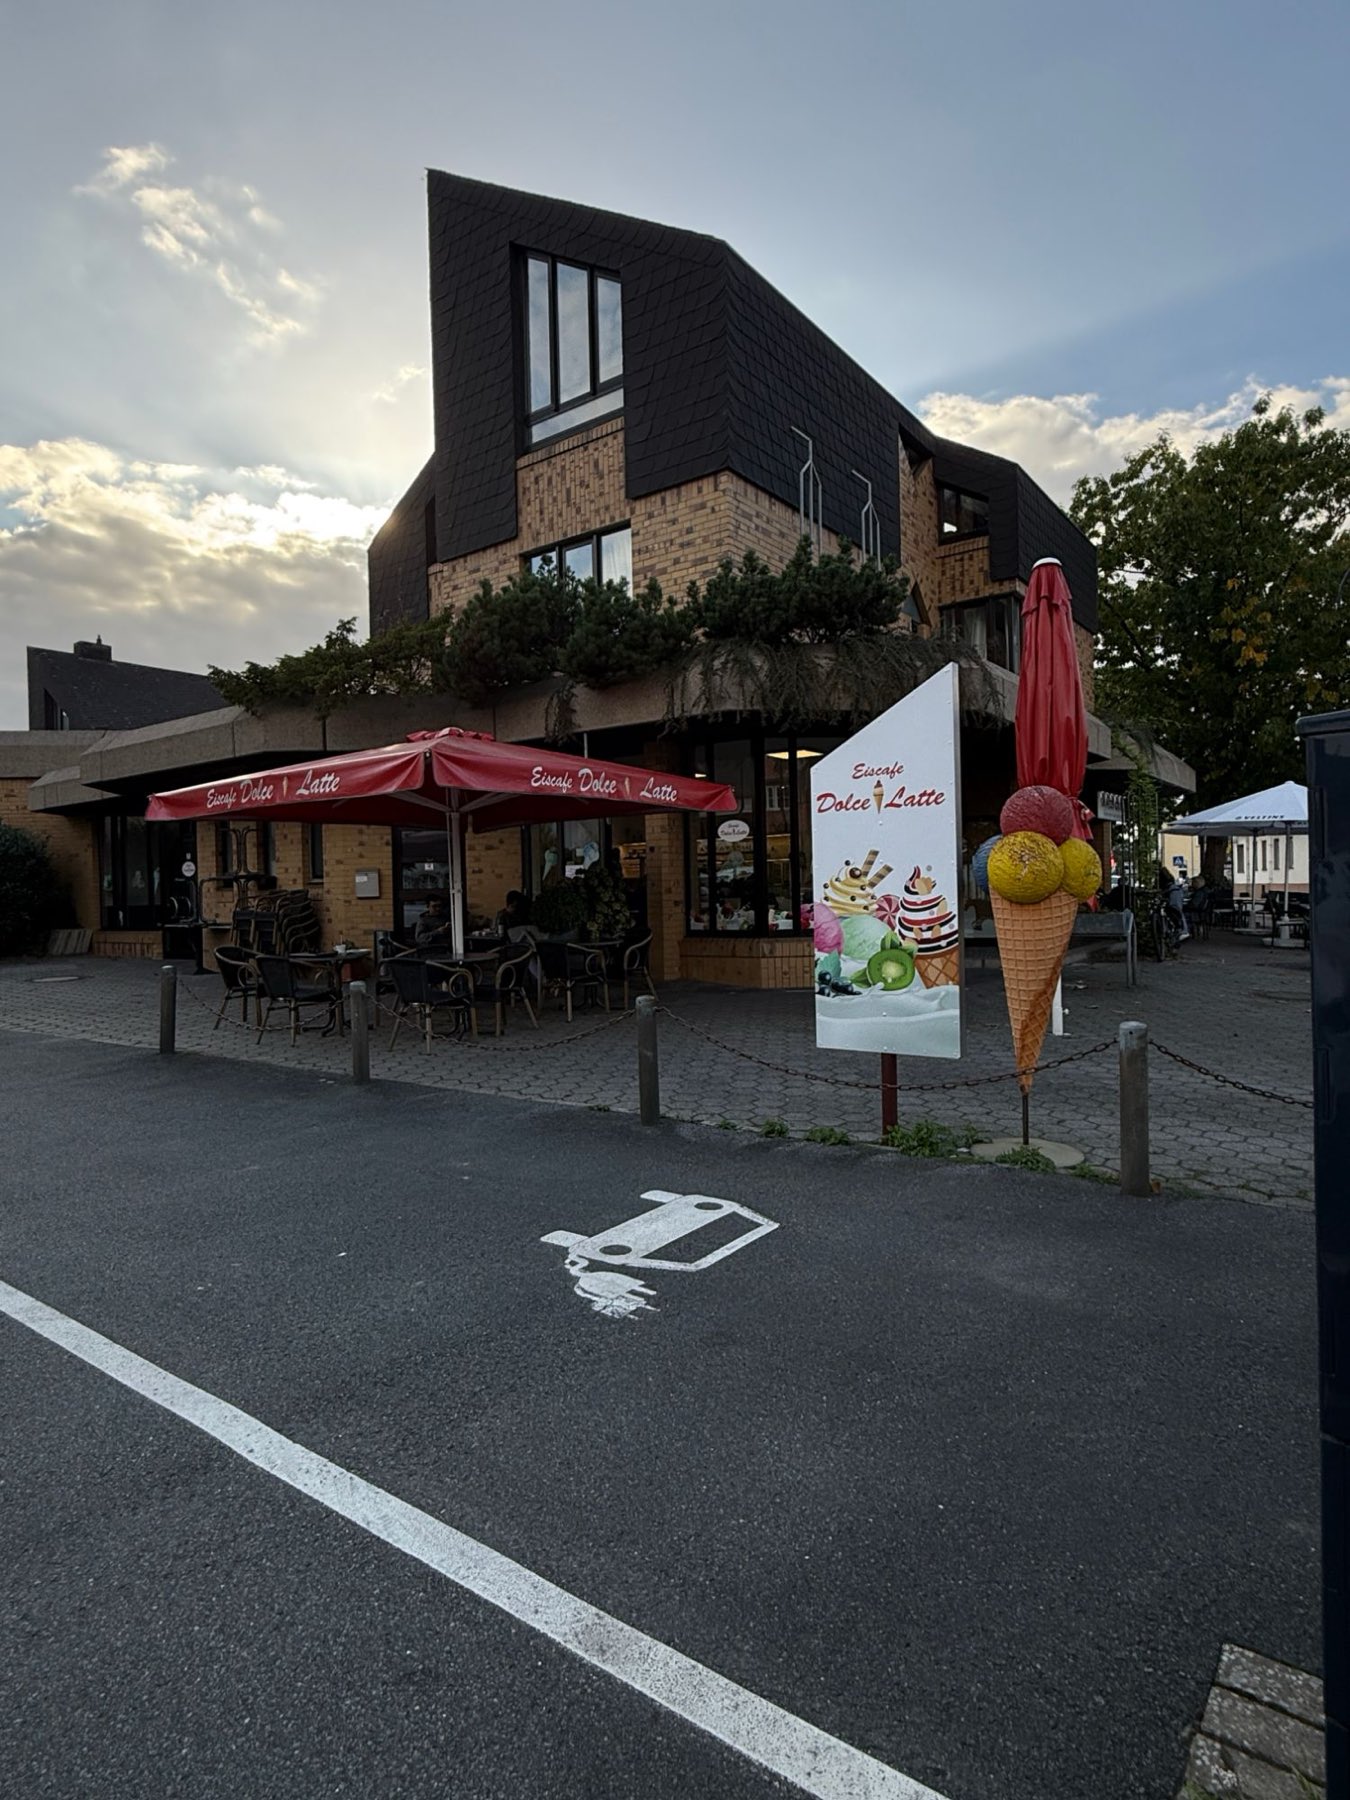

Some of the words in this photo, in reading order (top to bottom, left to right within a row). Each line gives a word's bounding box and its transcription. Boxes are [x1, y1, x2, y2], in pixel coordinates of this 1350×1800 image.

[530, 765, 573, 793] Eiscafe
[577, 767, 617, 794] Dolce
[639, 777, 679, 802] Latte
[852, 761, 904, 780] Eiscafe
[206, 788, 238, 810] Eiscafe
[240, 778, 275, 804] Dolce
[296, 768, 341, 796] Latte
[816, 792, 871, 814] Dolce
[884, 785, 946, 809] Latte
